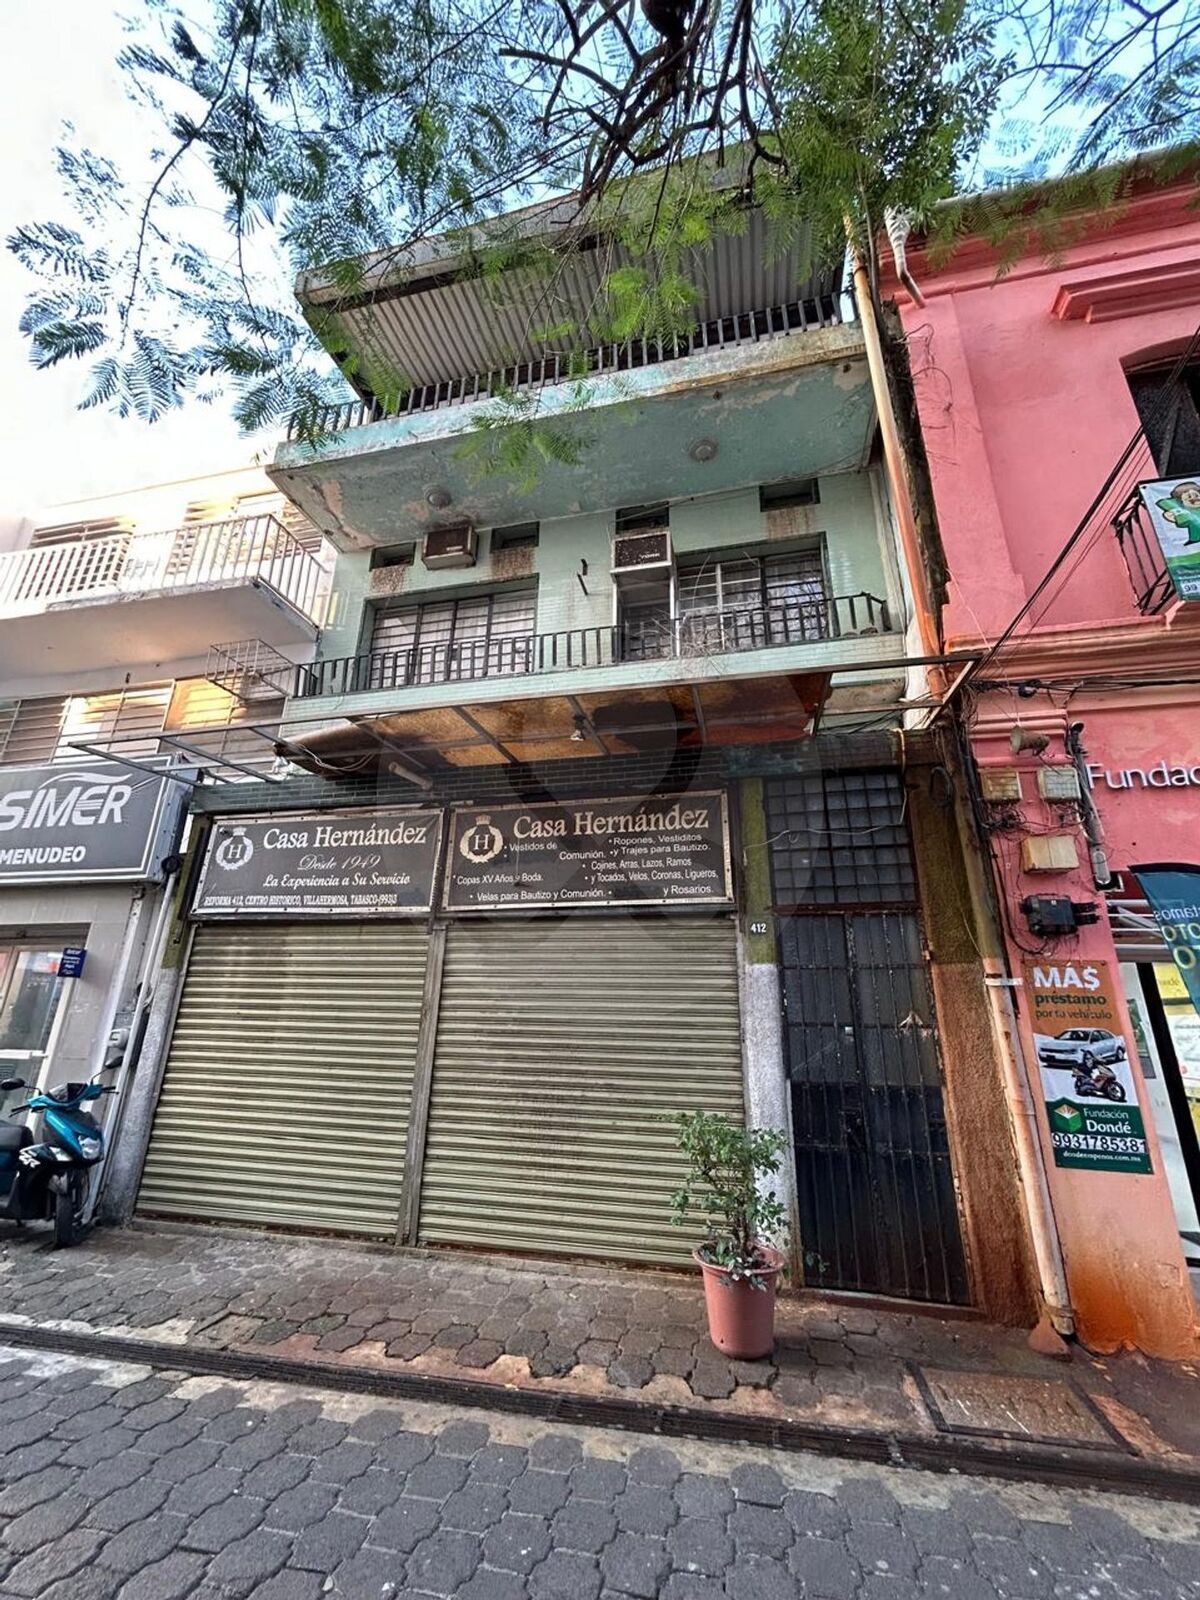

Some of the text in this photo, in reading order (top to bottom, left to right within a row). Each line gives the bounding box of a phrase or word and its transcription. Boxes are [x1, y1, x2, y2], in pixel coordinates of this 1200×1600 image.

[0, 785, 132, 831] SIMER
[513, 804, 709, 838] Casa Hernández
[263, 821, 427, 849] Casa Hernández
[474, 834, 490, 850] H
[227, 844, 242, 859] H
[509, 842, 557, 851] Vestidos de
[621, 846, 649, 856] Trajes
[650, 846, 671, 854] para
[0, 846, 86, 865] MENUDEO
[297, 854, 381, 870] Desde 1949
[666, 857, 692, 867] Ramos
[263, 874, 278, 887] La
[281, 874, 339, 890] Experiencia
[341, 877, 350, 886] a
[352, 872, 367, 886] Su
[457, 875, 480, 886] Copas
[482, 874, 494, 884] XV
[477, 891, 499, 901] Velas
[500, 891, 519, 902] para
[663, 887, 669, 898] y
[750, 923, 767, 933] 412
[1036, 1009, 1052, 1020] por
[1055, 1008, 1065, 1018] tu
[1083, 1107, 1130, 1119] Fundación
[1086, 1119, 1132, 1134] Dondé
[1053, 1132, 1147, 1153] 9931785381
